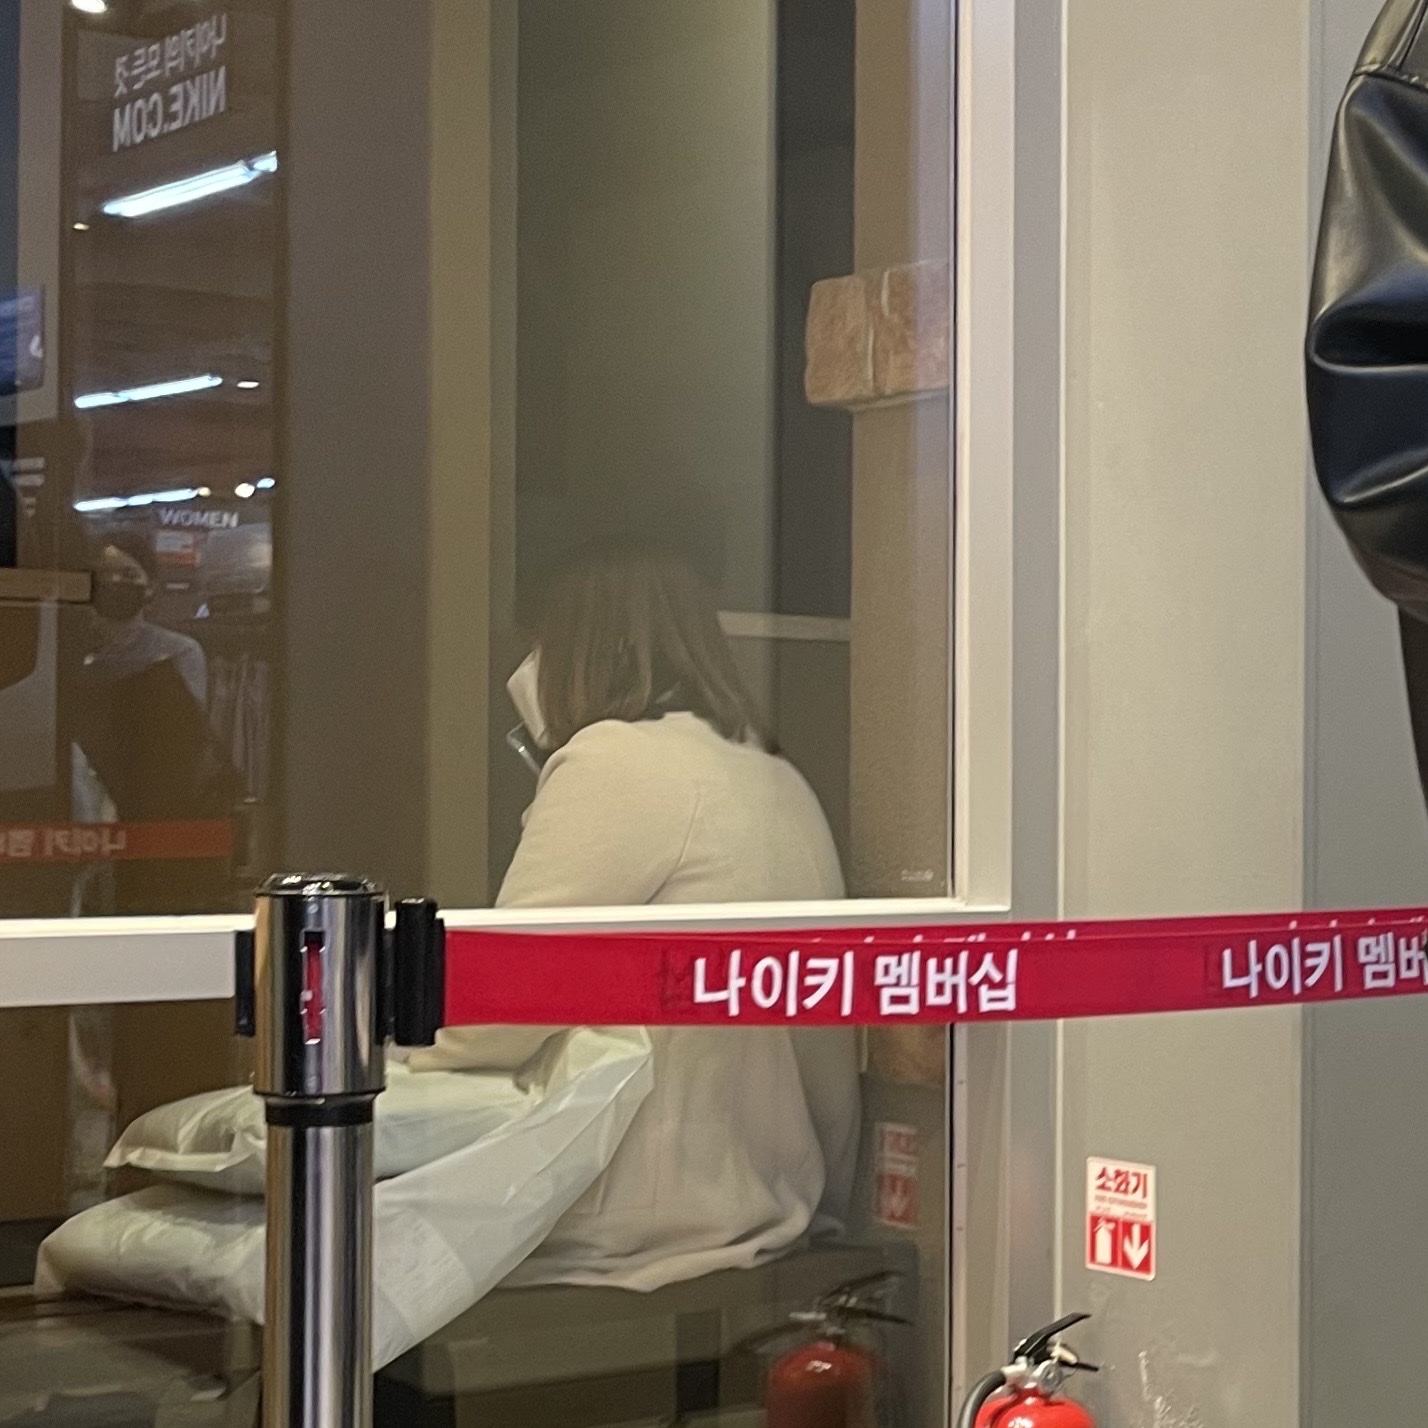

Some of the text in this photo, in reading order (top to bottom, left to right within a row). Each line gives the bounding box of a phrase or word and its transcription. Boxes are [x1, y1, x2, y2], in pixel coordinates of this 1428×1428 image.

[160, 508, 239, 528] WOMEN
[693, 948, 1019, 1016] 나이키 멤버십
[1221, 938, 1344, 999] 나이키
[1095, 1166, 1148, 1199] 소화기
